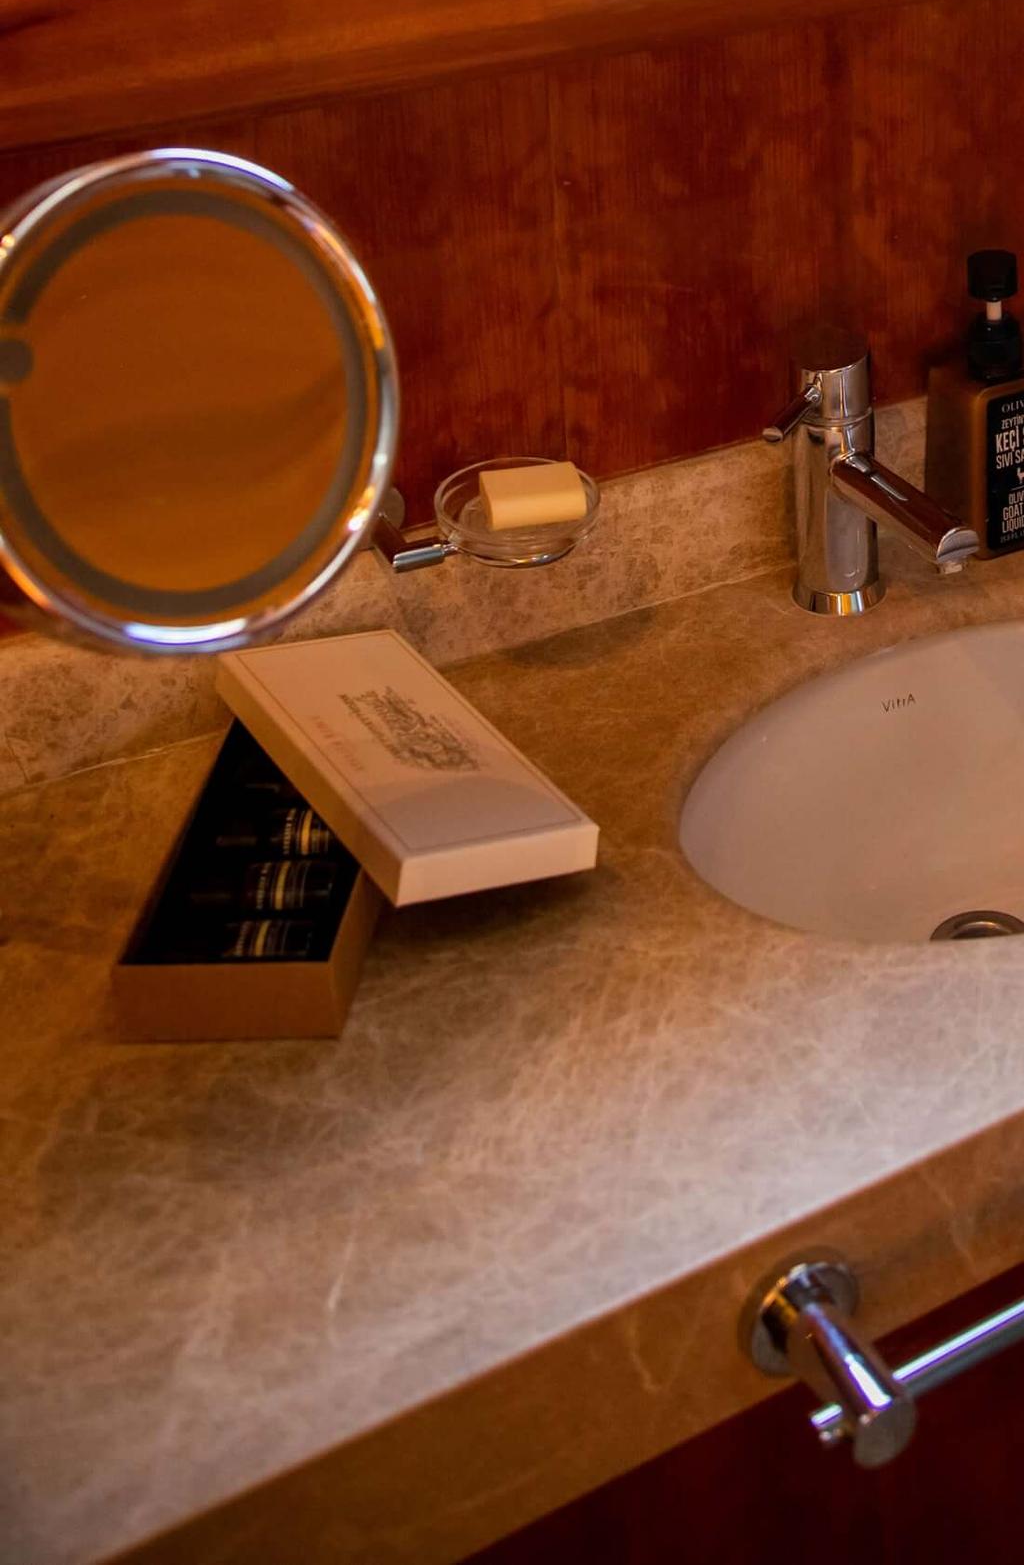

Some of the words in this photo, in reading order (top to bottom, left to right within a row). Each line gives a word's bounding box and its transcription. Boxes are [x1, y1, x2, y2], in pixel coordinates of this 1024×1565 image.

[995, 425, 1020, 454] KEÇİ
[996, 451, 1013, 469] SIVI
[1003, 503, 1024, 521] GOAT
